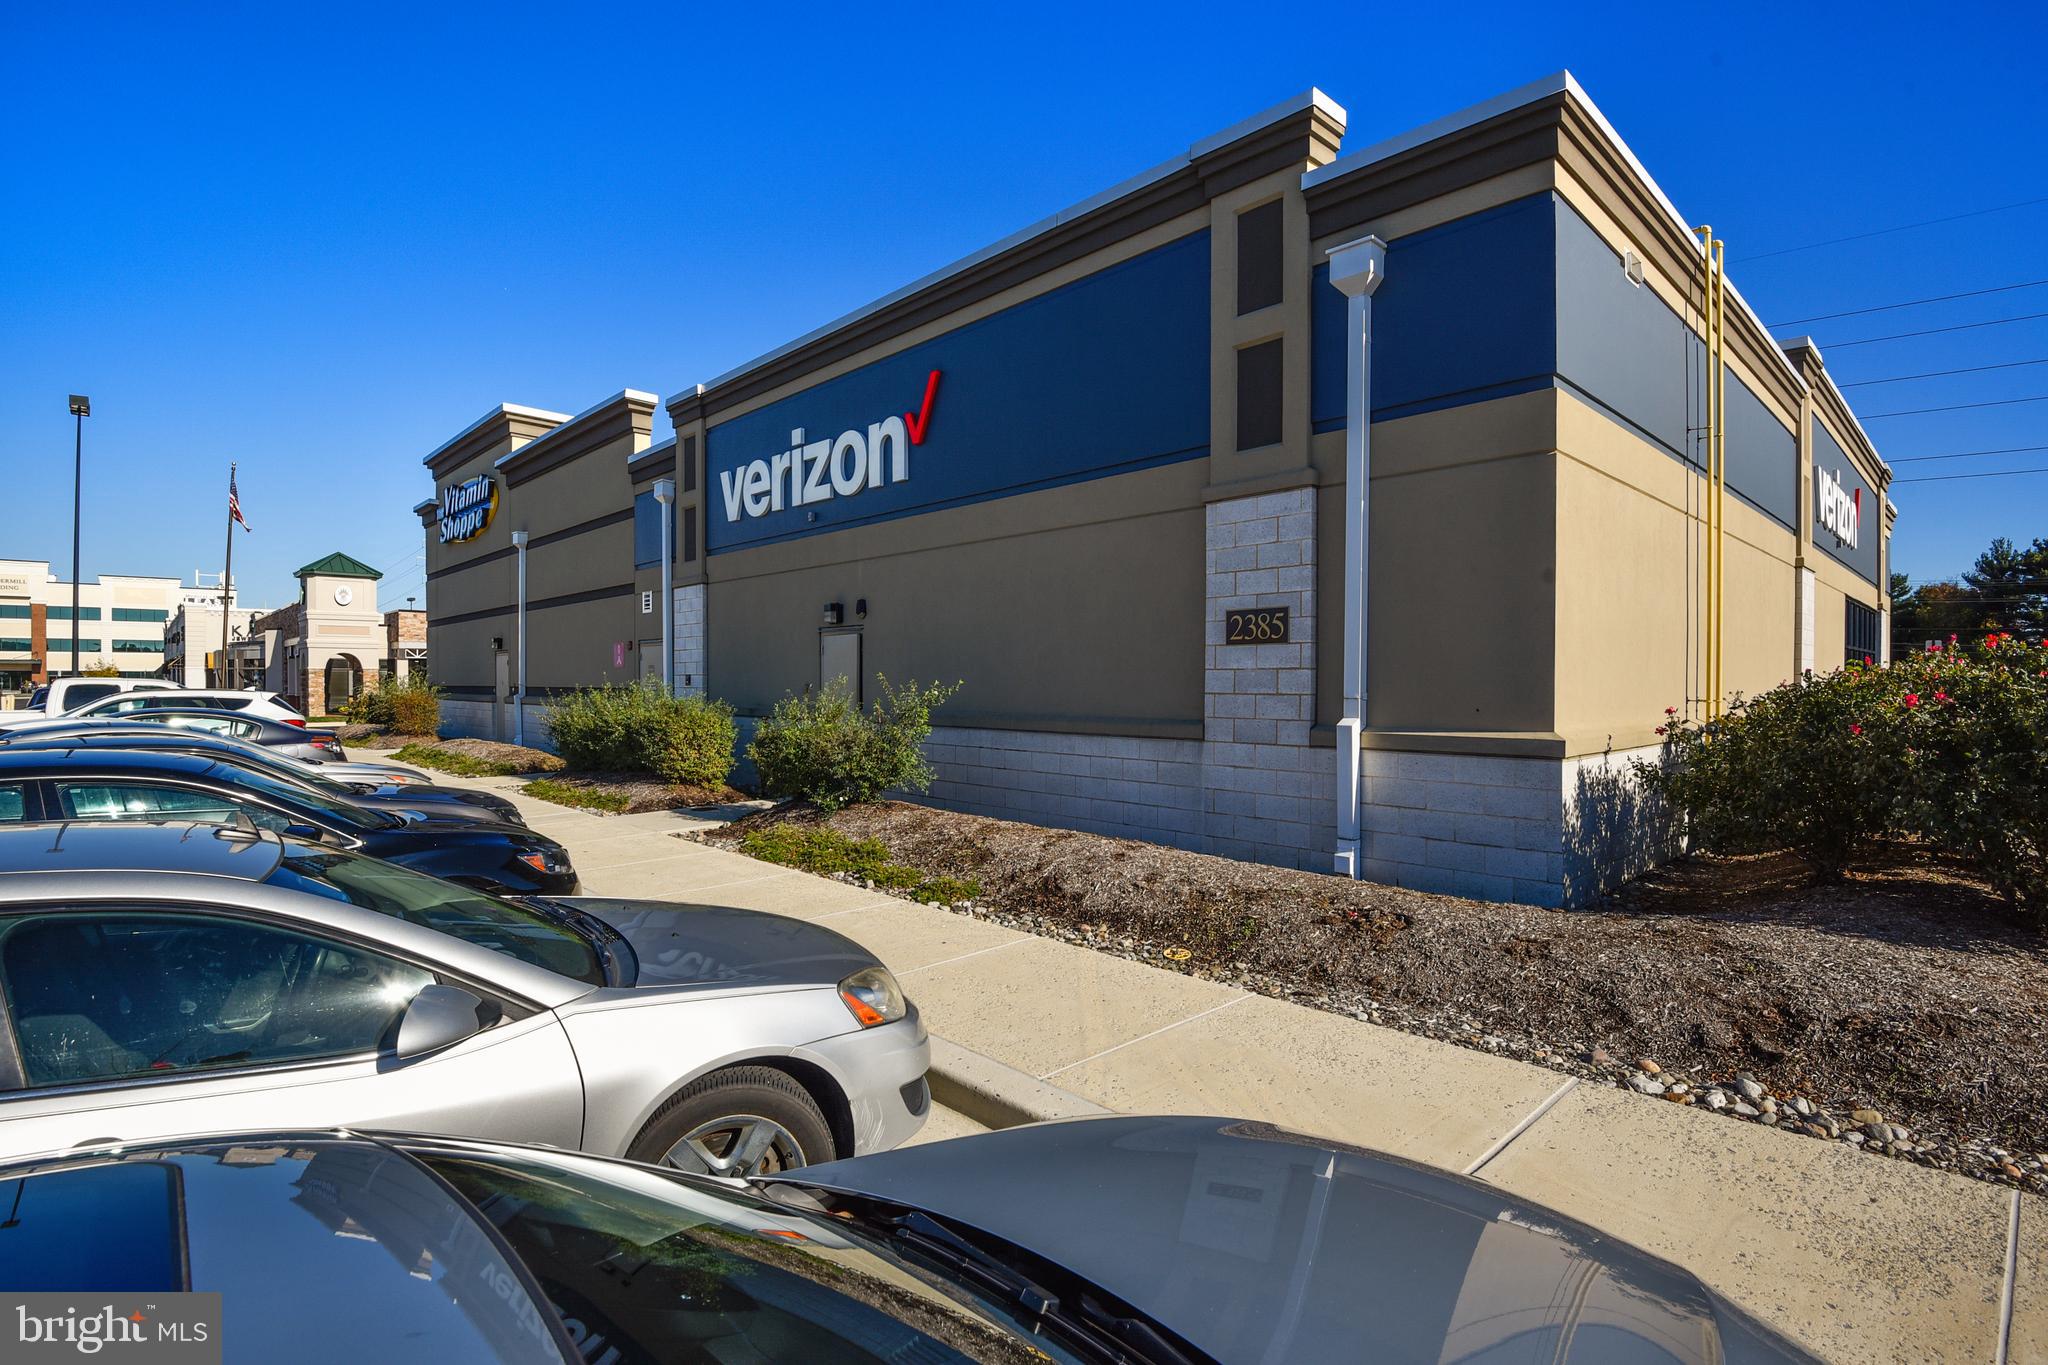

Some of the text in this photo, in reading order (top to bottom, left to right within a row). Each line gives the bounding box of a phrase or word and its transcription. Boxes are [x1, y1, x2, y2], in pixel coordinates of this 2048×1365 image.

[720, 415, 909, 522] verizon
[444, 474, 489, 516] Vitamin
[1817, 465, 1858, 549] verizon
[440, 509, 483, 544] Shoppe
[1230, 612, 1285, 641] 2385
